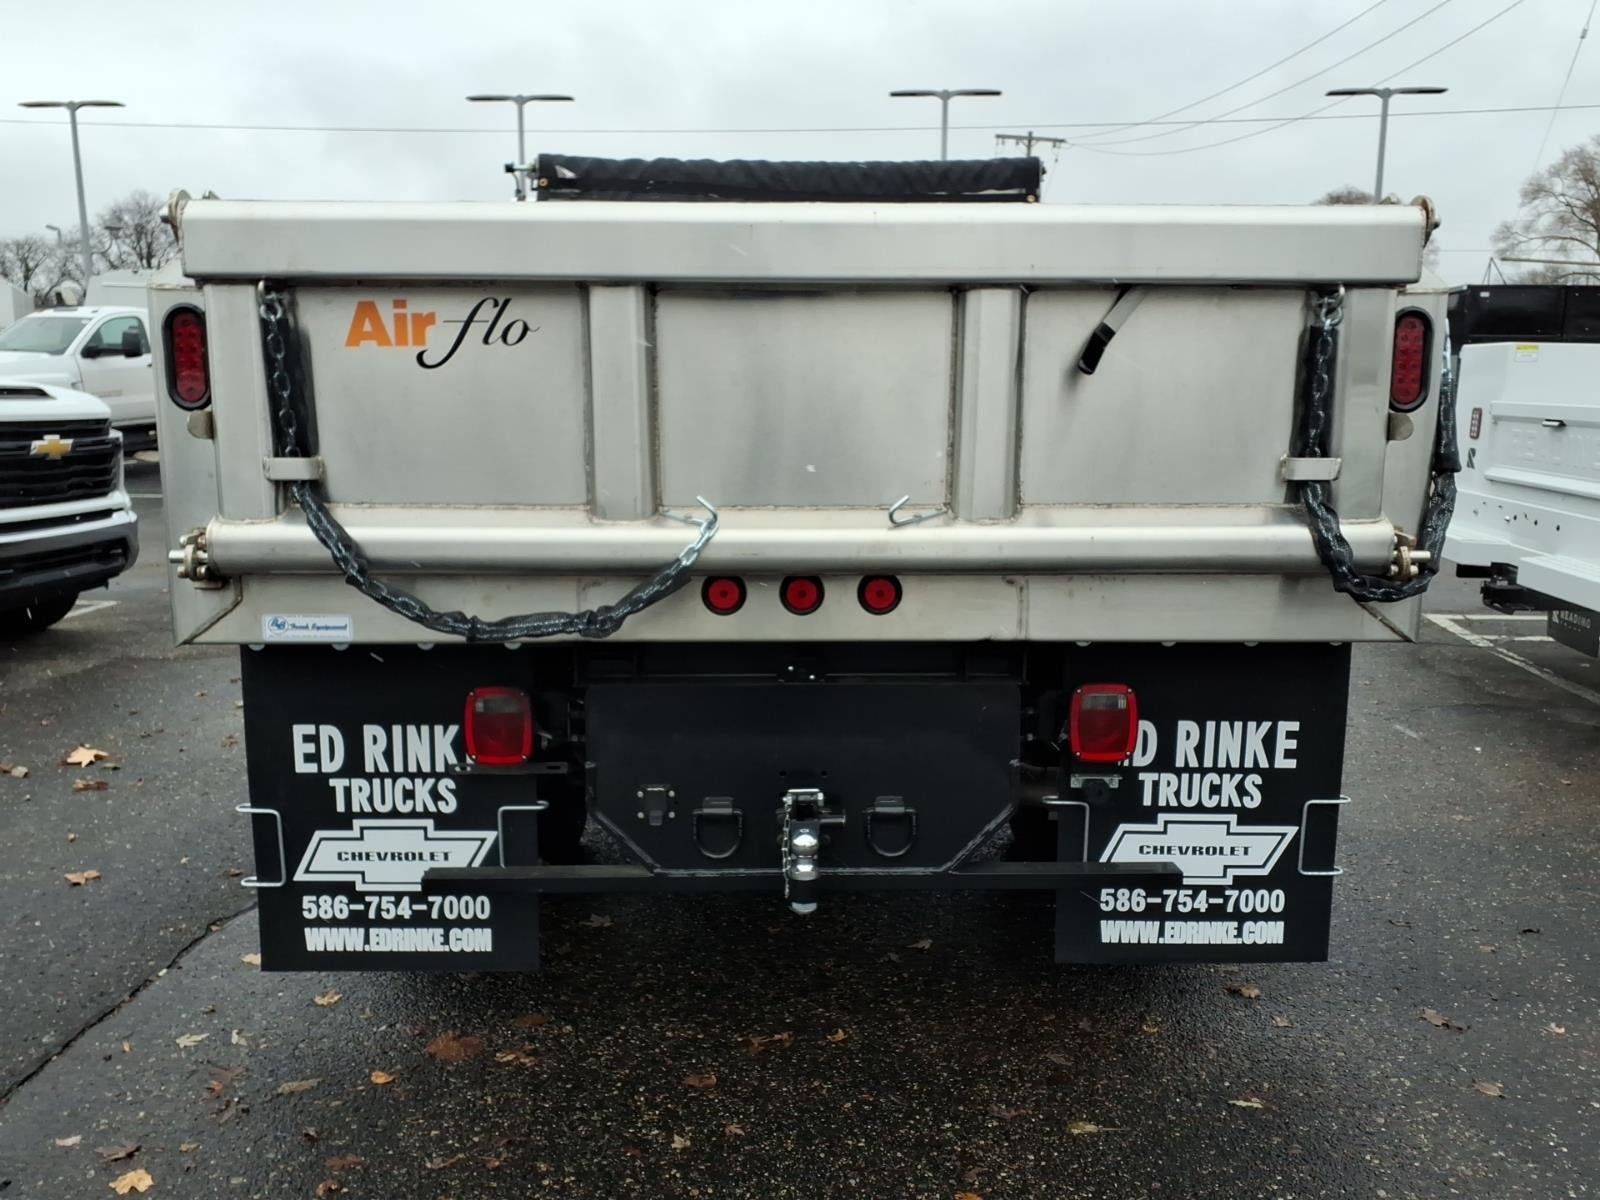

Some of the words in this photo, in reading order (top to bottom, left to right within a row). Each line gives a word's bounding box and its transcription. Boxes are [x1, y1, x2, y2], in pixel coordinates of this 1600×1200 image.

[345, 299, 437, 348] Air
[416, 297, 540, 369] flo
[292, 724, 345, 773] ED
[363, 724, 475, 773] RINK
[1118, 719, 1158, 767] D
[1175, 720, 1300, 769] RINKE
[328, 777, 458, 814] TRUCKS
[1138, 772, 1263, 809] TRUCKS
[336, 850, 453, 863] CHEVROLET
[1137, 844, 1252, 857] CHEVROLET
[302, 895, 491, 920] 586-754-7000
[1099, 888, 1286, 913] 586-754-7000
[303, 927, 493, 953] WWW.EDRINKE.COM
[1100, 920, 1285, 945] WWW.EDRINKE.COM
